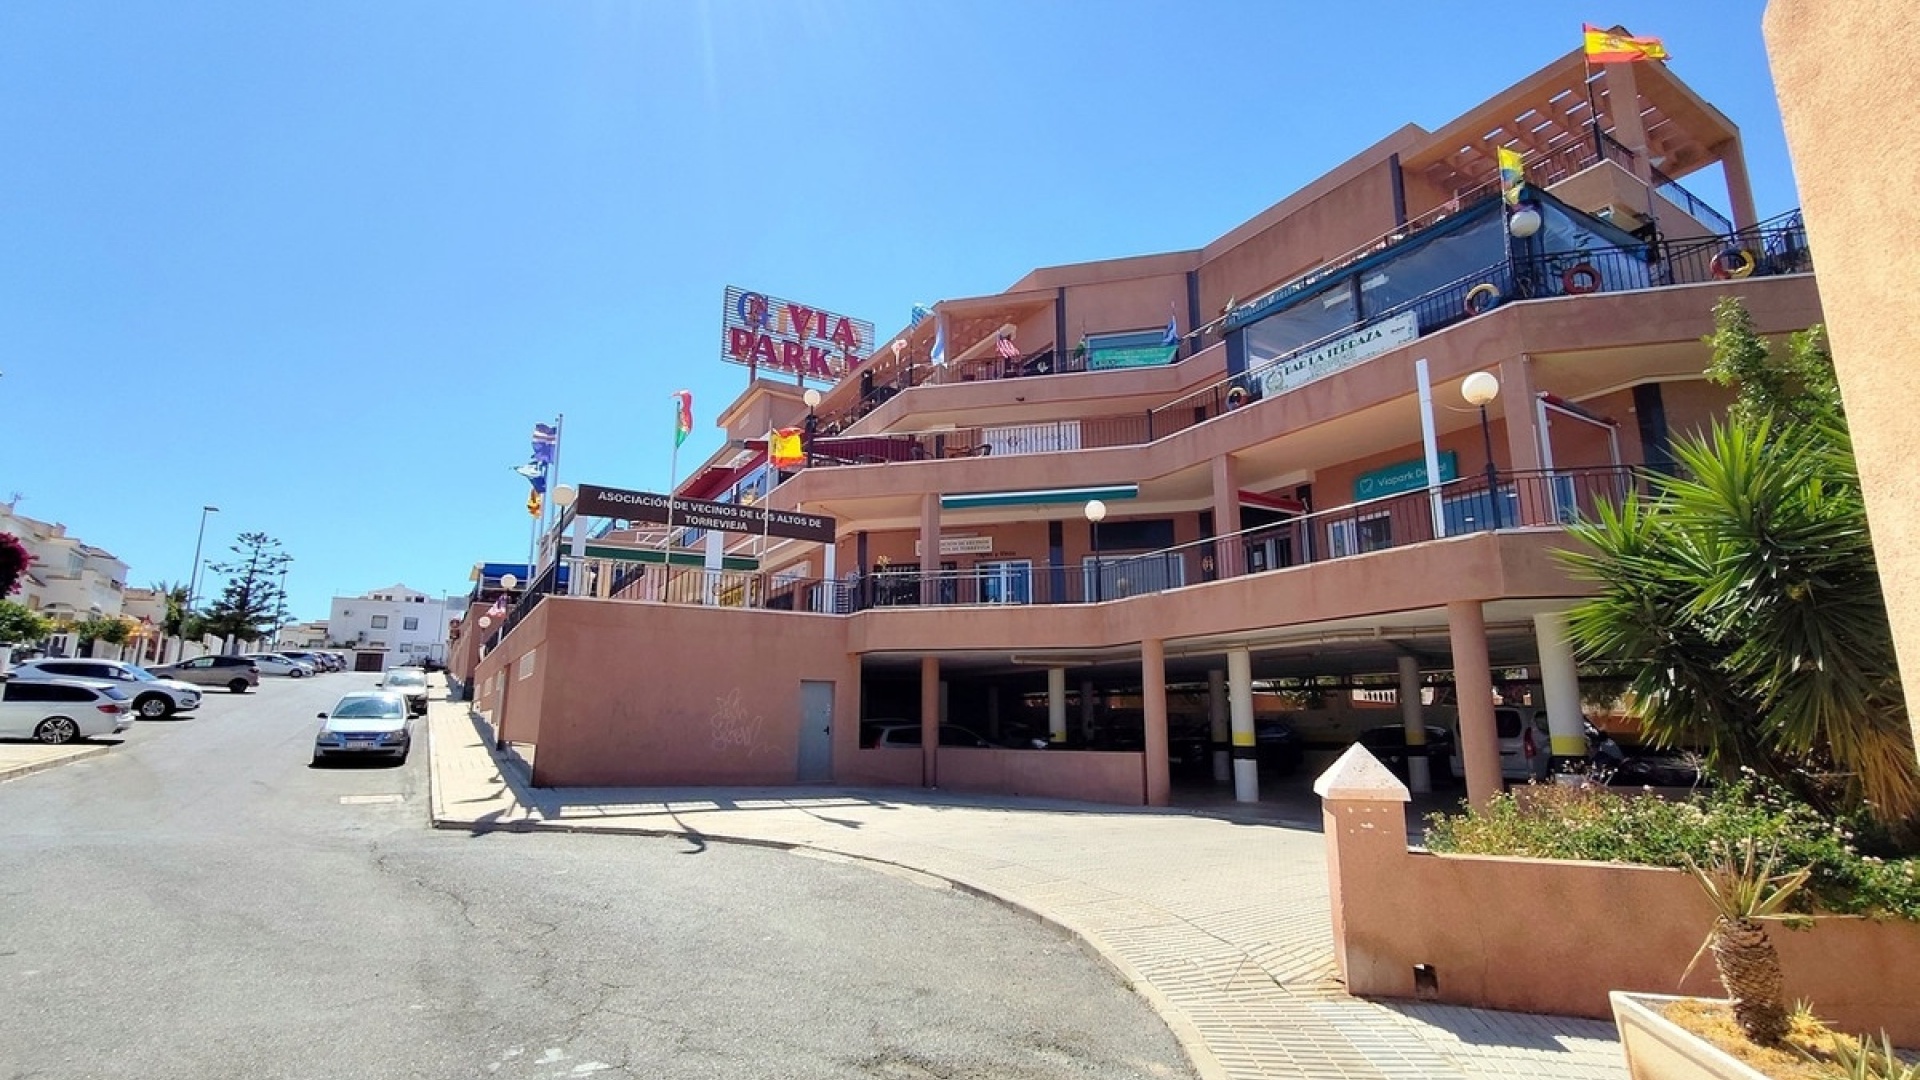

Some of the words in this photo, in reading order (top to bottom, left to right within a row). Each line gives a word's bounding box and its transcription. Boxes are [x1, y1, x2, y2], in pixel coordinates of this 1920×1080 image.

[787, 304, 857, 347] VIA
[730, 327, 832, 376] PARK
[1377, 470, 1414, 487] Viapark
[1415, 462, 1447, 479] Deal
[598, 491, 671, 509] ASOCIACIÓN
[674, 501, 689, 511] DE
[690, 502, 737, 517] VECINOS
[740, 509, 755, 519] DE
[756, 511, 776, 523] LOS
[777, 514, 807, 526] ALTOS
[808, 518, 822, 528] DE
[685, 514, 748, 531] TORREVIEJA
